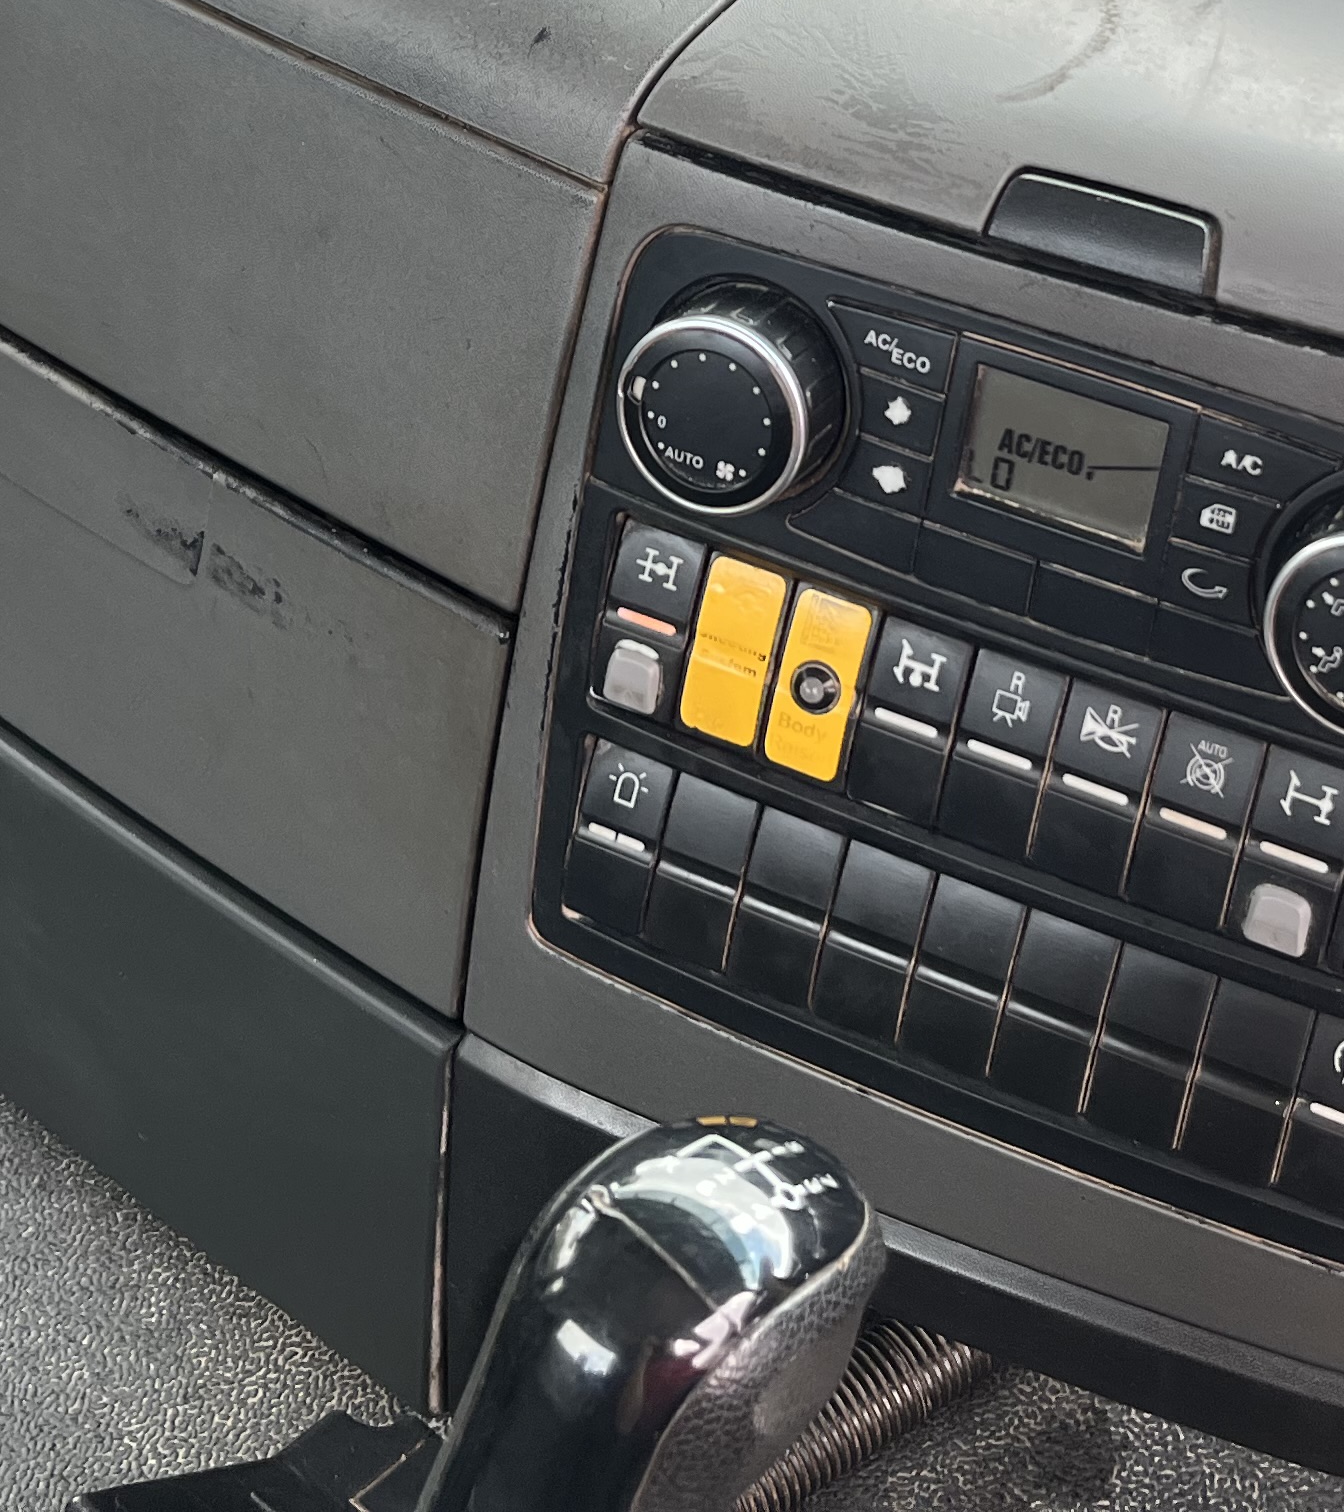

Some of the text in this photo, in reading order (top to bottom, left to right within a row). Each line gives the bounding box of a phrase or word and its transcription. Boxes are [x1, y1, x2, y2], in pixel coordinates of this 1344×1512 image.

[664, 446, 704, 469] AUTO
[1220, 448, 1263, 476] A/C
[1198, 739, 1228, 759] AUTO
